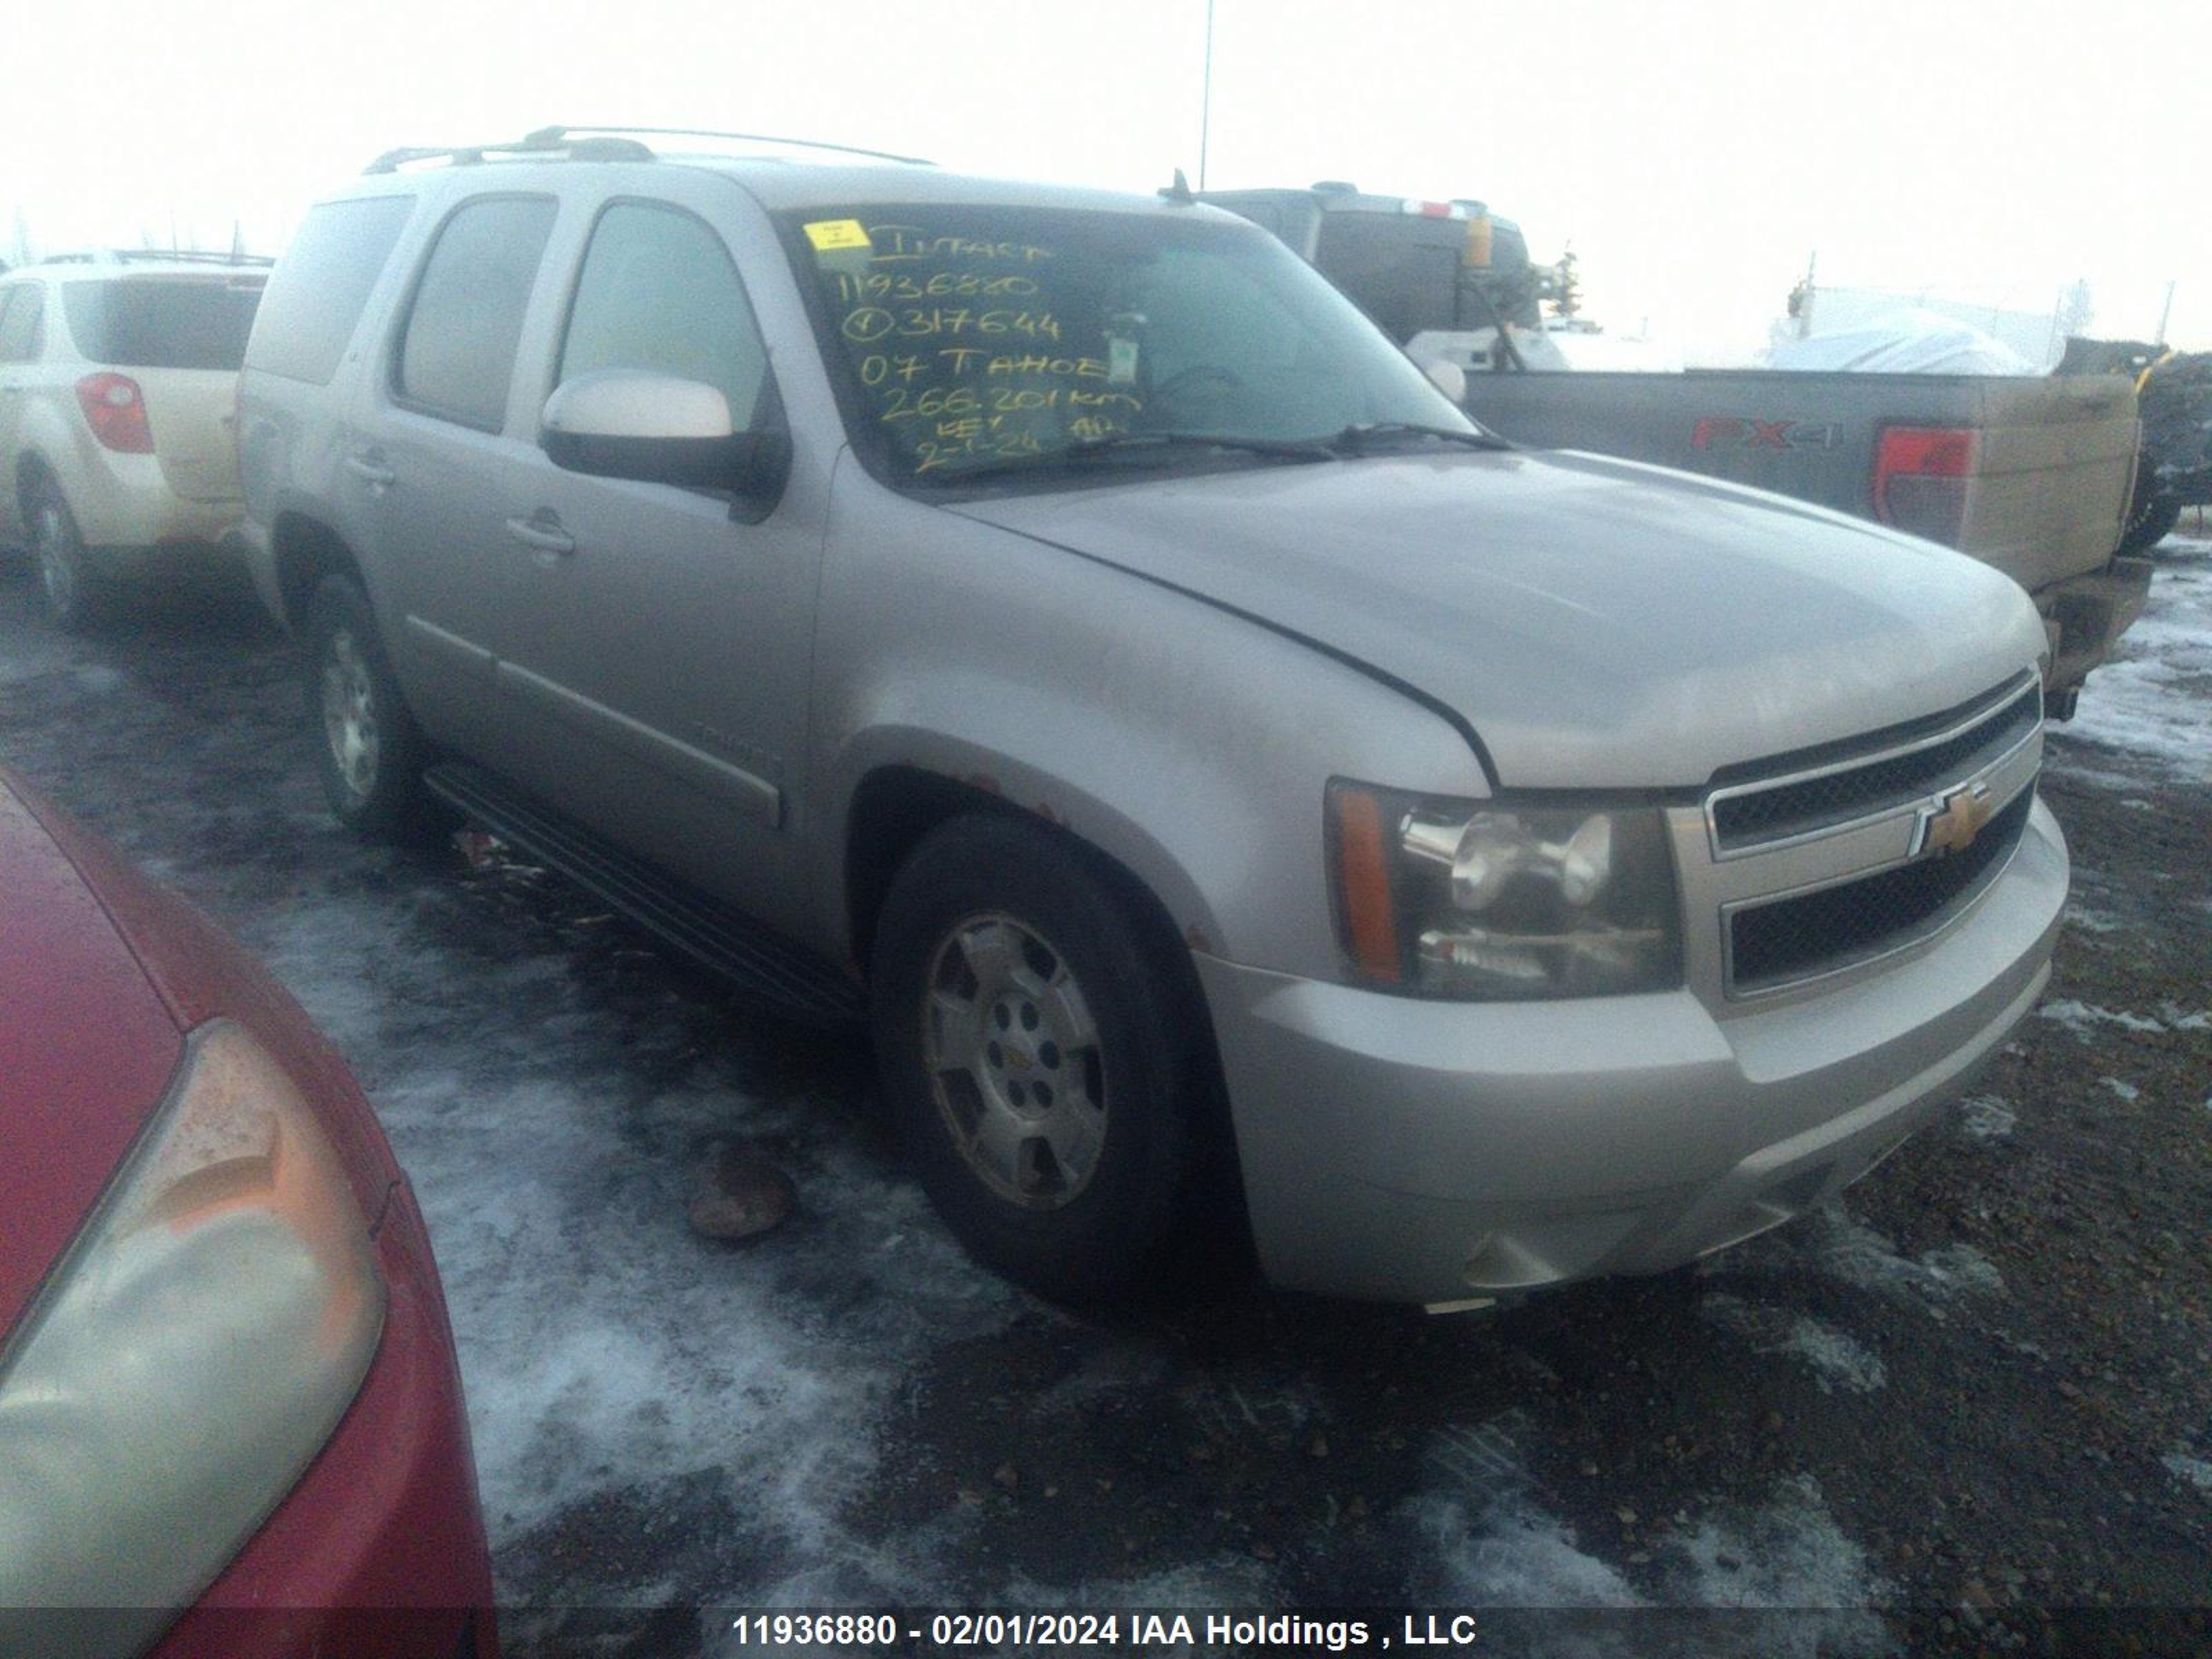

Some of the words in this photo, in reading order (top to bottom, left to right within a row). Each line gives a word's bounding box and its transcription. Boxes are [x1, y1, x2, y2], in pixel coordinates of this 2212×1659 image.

[899, 309, 1062, 341] 317644
[861, 354, 930, 386] 07
[939, 348, 1107, 377] TAHOE
